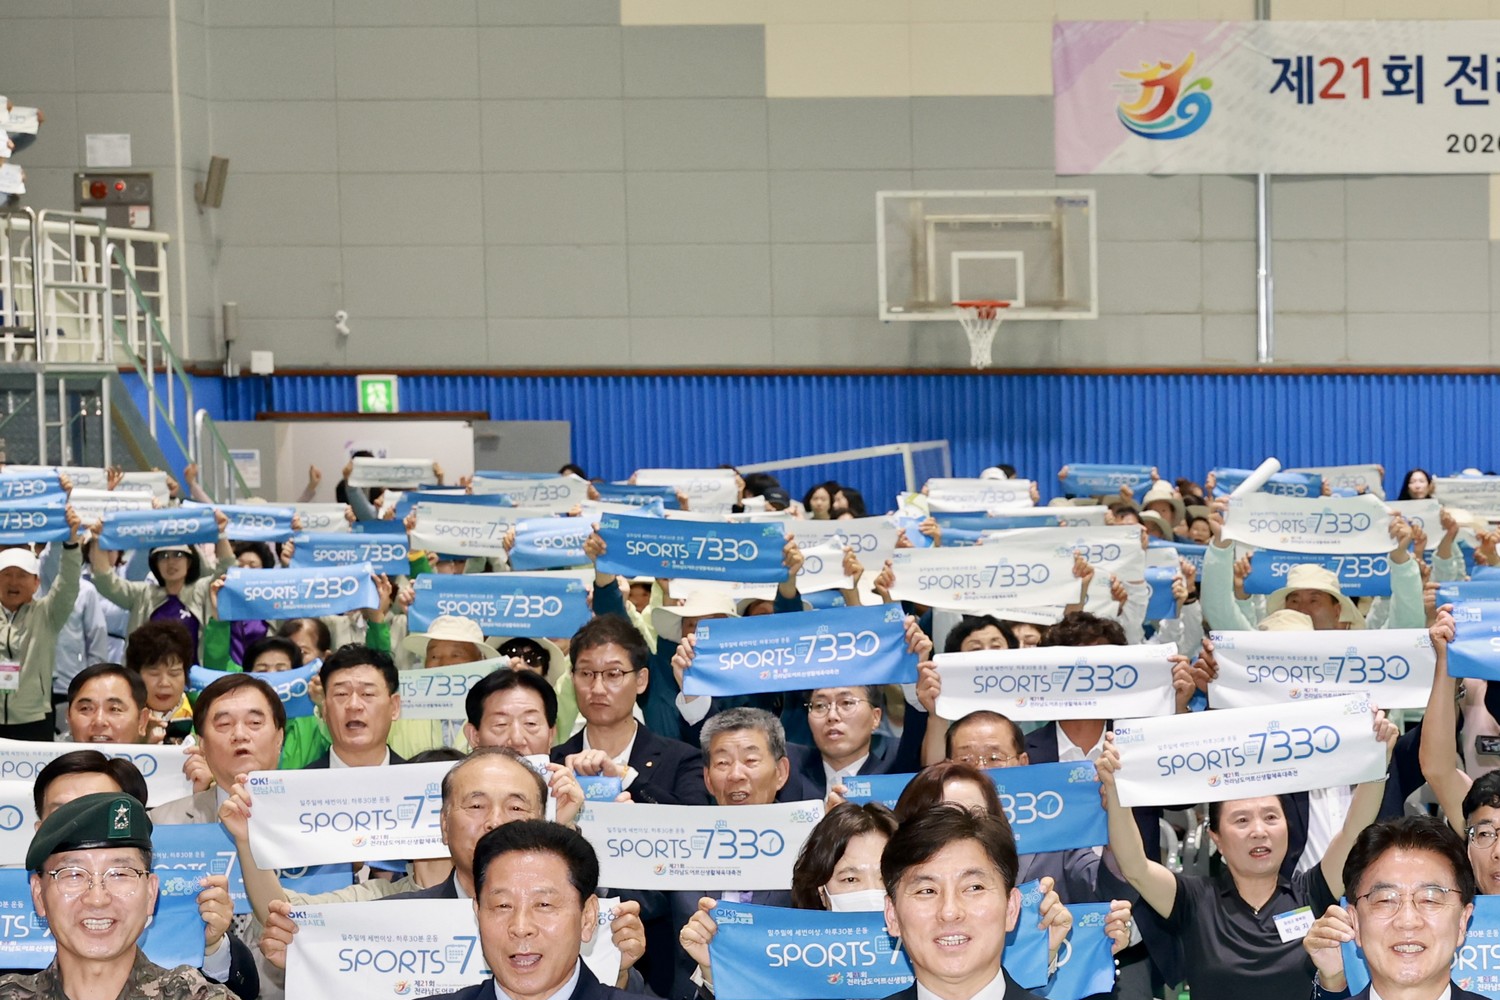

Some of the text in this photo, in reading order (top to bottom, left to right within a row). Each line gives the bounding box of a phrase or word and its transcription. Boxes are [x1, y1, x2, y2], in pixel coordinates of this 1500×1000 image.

[1269, 54, 1425, 105] 제21회
[117, 518, 199, 537] SPORTS 7330
[1249, 512, 1371, 536] SPORTS 7330
[313, 543, 407, 562] SPORTS 7330
[626, 537, 760, 561] SPORTS 7330
[244, 570, 360, 601] SPORTS 7330
[919, 564, 1050, 590] SPORTS 7330
[437, 594, 563, 617] SPORTS 7330
[718, 630, 881, 672] SPORTS 7330
[973, 665, 1139, 695] SPORTS 7330
[1246, 654, 1410, 684] SPORTS 7330
[1157, 725, 1341, 777] SPORTS 7330
[299, 809, 397, 833] SPORTS
[606, 828, 786, 860] SPORTS 7330
[338, 947, 445, 974] SPORTS
[765, 939, 876, 968] SPORTS
